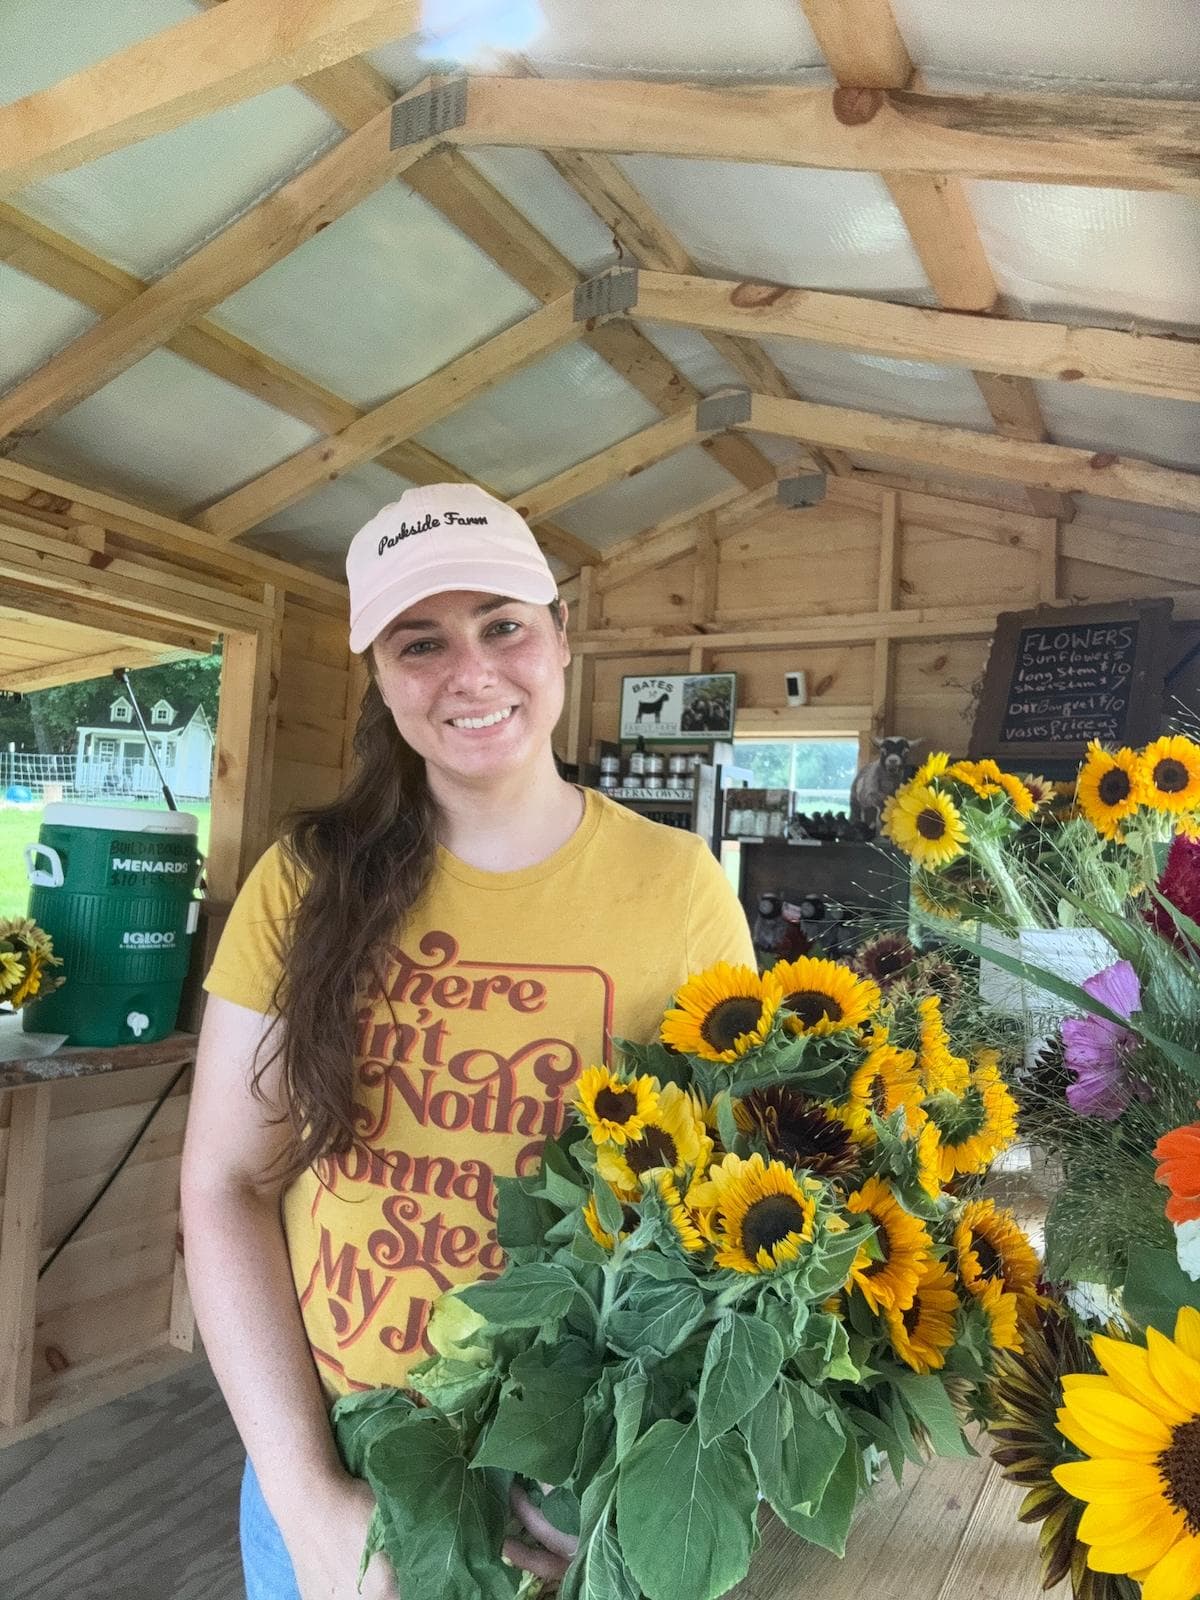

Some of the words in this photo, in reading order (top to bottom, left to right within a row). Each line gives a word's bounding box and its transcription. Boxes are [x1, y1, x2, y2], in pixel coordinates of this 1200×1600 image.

[378, 514, 440, 556] Parkside
[444, 512, 488, 525] Farm
[1023, 626, 1133, 652] FLOWERS
[1018, 669, 1053, 684] long
[1100, 660, 1131, 675] $10
[632, 680, 674, 694] BATES
[112, 858, 188, 873] MENARDS
[123, 932, 175, 944] IGLOO
[357, 1004, 452, 1066] in't
[300, 1223, 397, 1350] My
